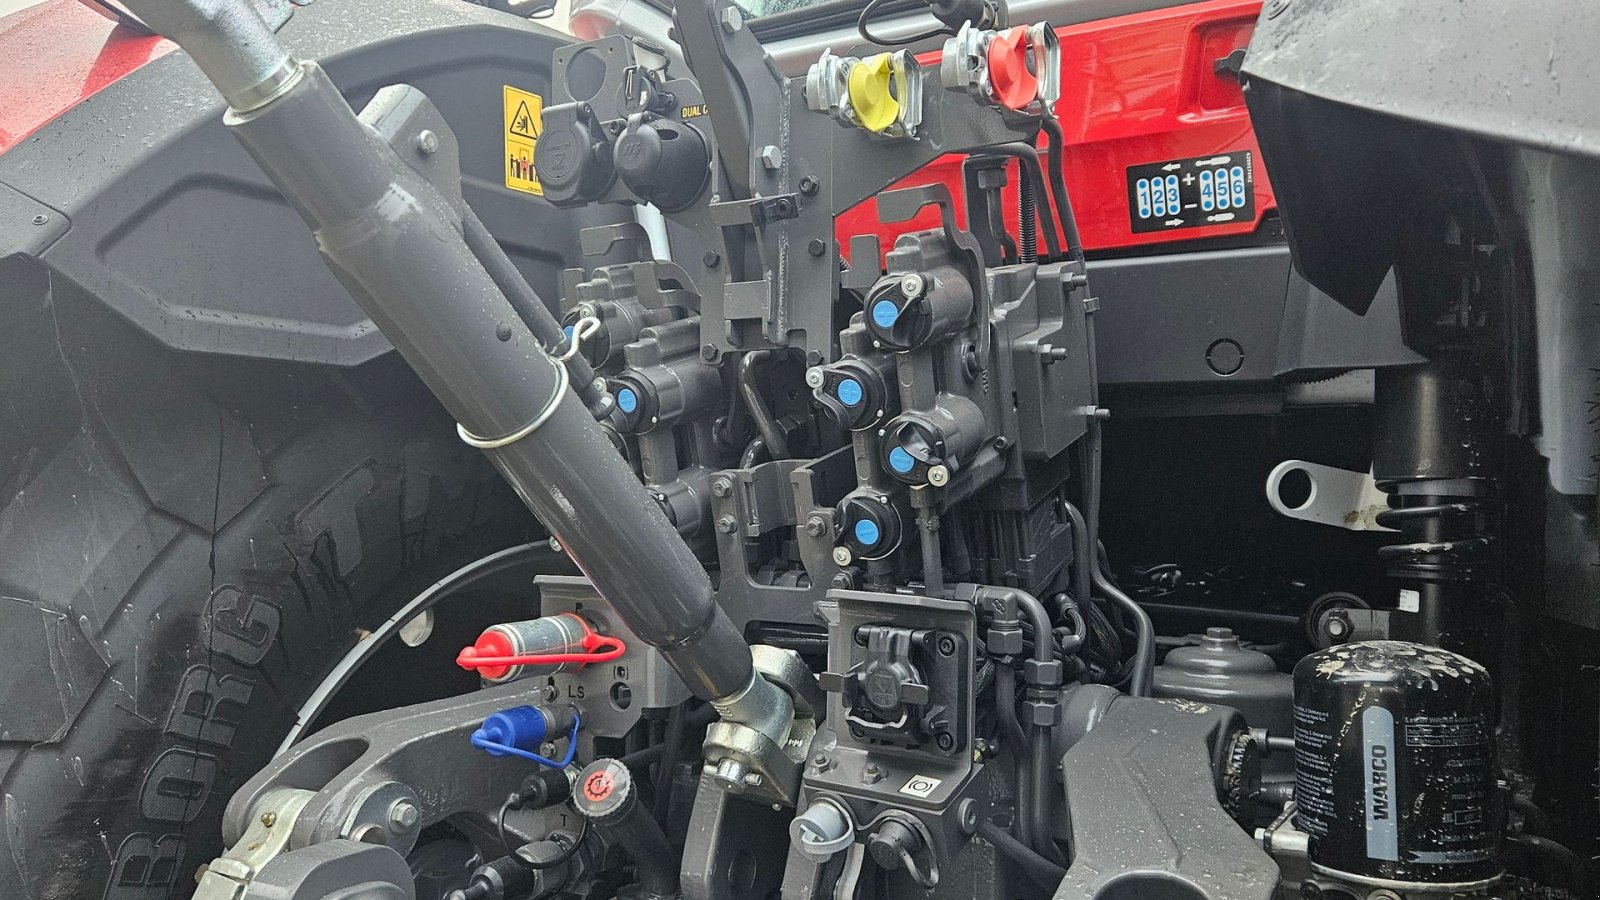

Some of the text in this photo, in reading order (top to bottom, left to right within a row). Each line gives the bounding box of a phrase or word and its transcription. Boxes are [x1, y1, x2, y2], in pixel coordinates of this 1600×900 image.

[682, 106, 701, 118] DUAL
[1140, 180, 1243, 206] 1 2 3 4 5 6
[568, 684, 585, 699] LS
[1371, 744, 1389, 821] WABCO
[560, 813, 567, 827] T
